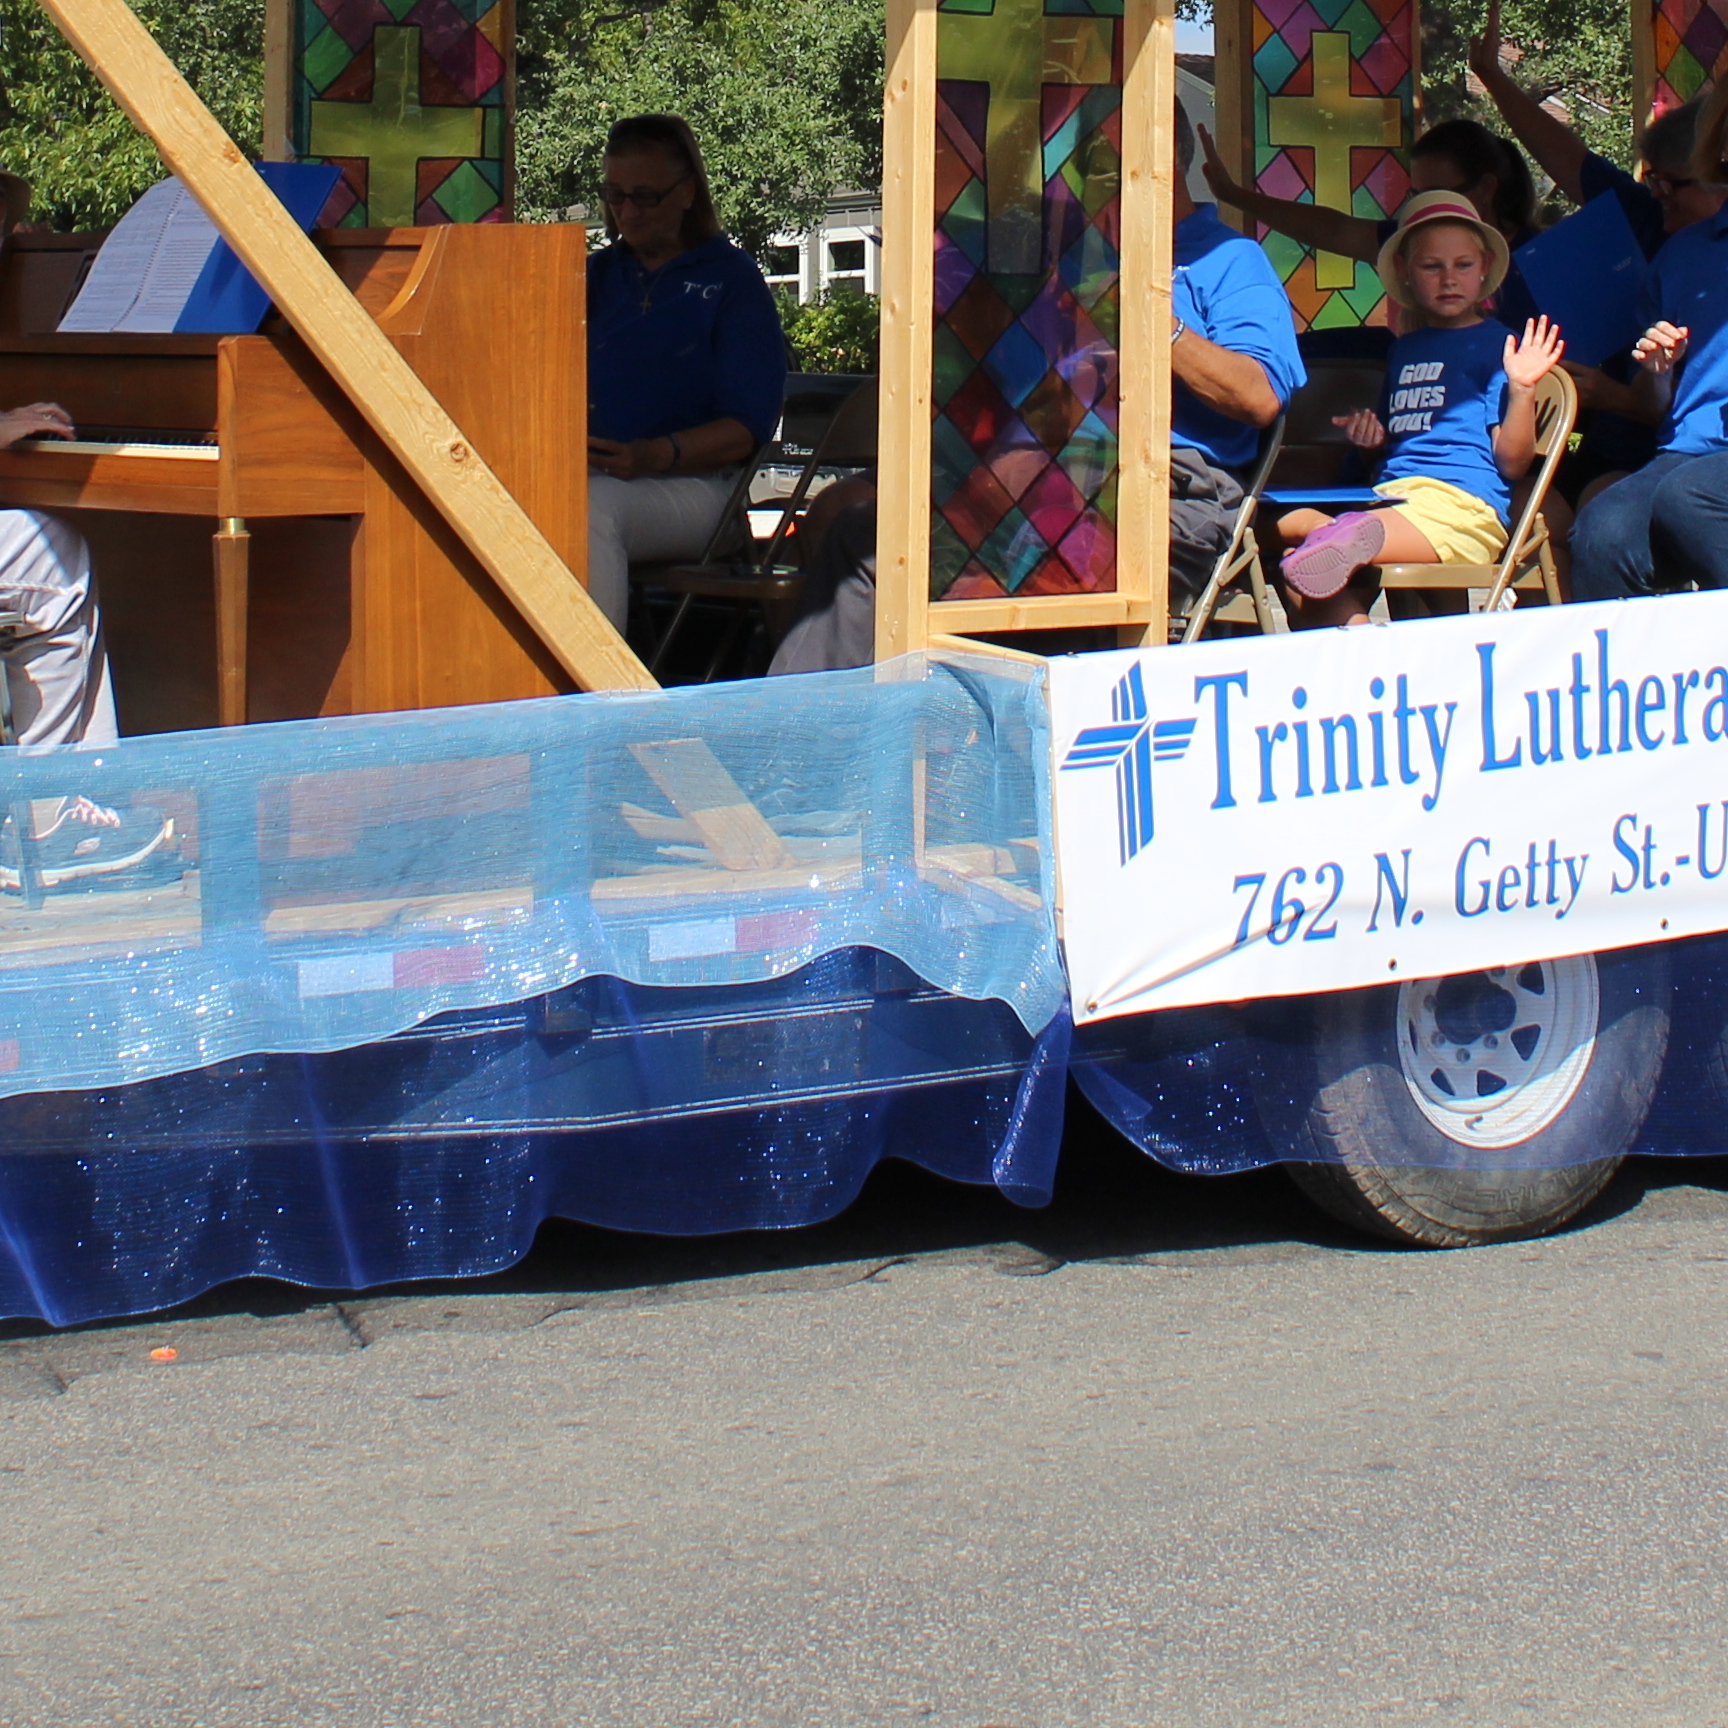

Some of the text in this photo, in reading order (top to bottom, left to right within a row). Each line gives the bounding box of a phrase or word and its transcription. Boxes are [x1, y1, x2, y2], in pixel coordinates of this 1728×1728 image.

[1389, 385, 1446, 414] LOVES
[1398, 361, 1445, 385] GOD
[1193, 668, 1459, 812] Trinity
[1230, 861, 1344, 950] 762
[1365, 848, 1424, 934] N.
[1454, 836, 1590, 921] Getty
